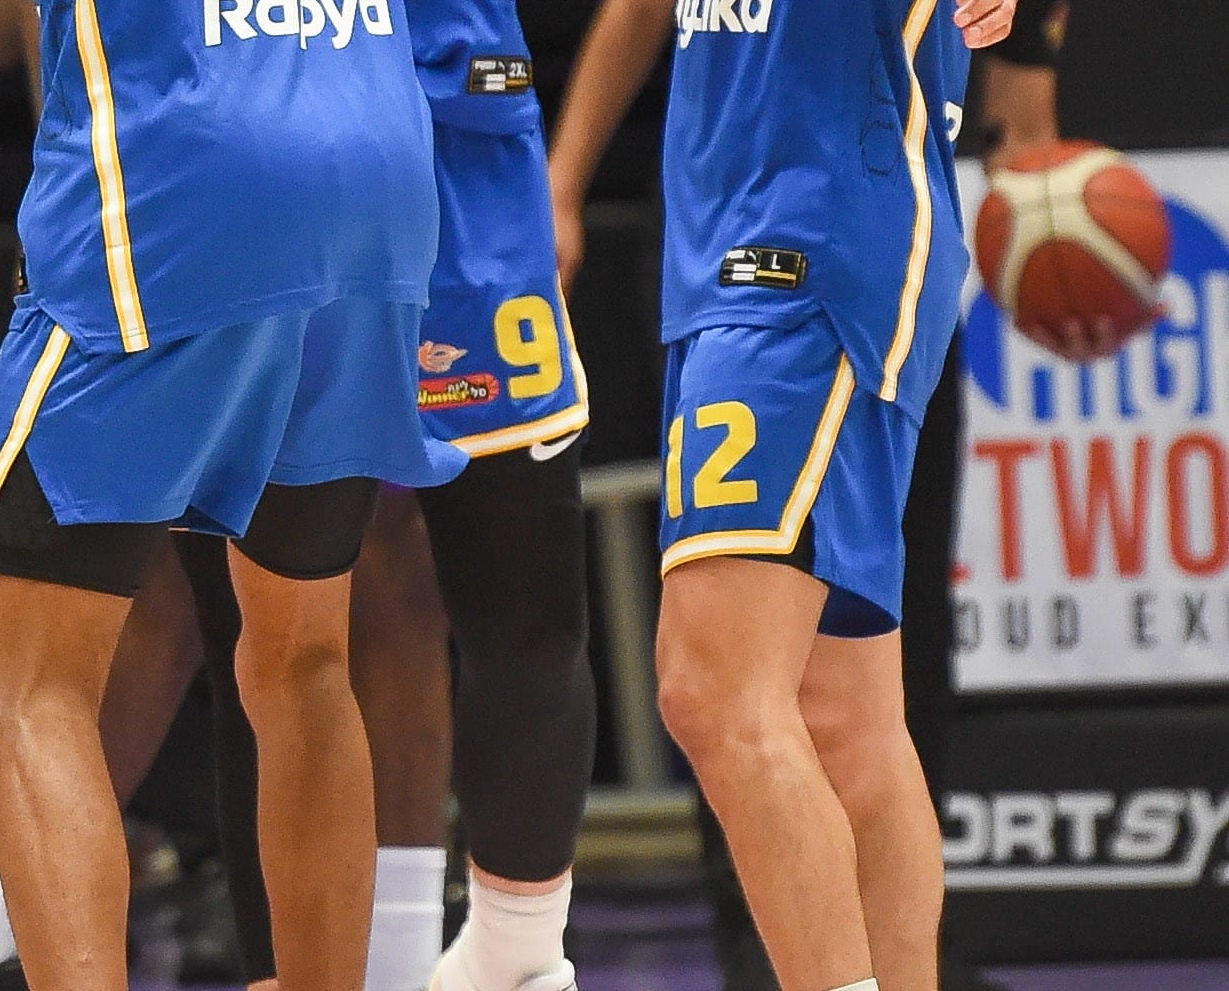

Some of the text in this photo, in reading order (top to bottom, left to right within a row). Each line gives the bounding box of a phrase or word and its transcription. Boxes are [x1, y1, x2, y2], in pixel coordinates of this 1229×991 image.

[772, 253, 781, 269] L
[494, 295, 563, 399] 9
[666, 400, 758, 518] 12
